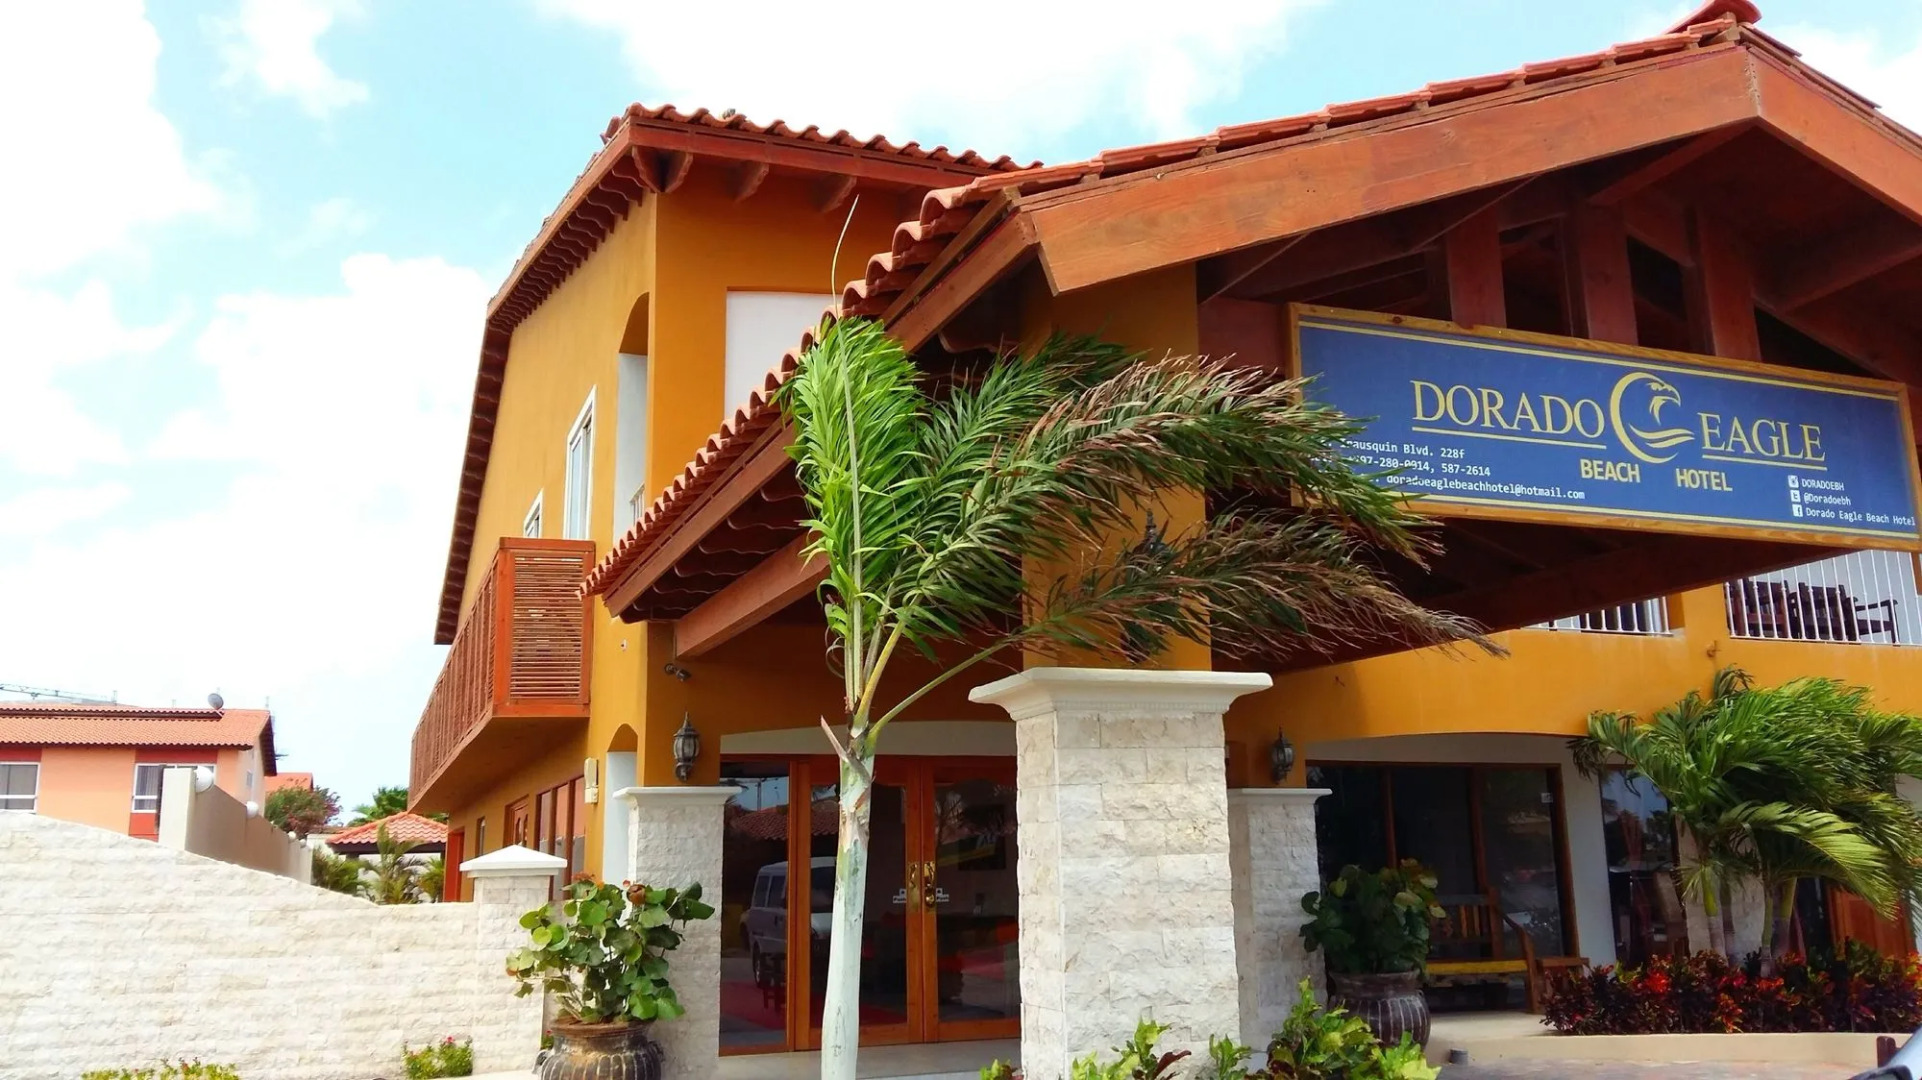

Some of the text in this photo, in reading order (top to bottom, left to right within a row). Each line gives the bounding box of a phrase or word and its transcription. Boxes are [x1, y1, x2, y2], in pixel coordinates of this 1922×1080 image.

[1410, 380, 1826, 462] DORADO EAGLE
[1403, 444, 1434, 456] Blvd.
[1440, 447, 1465, 459] 228f
[1441, 463, 1491, 476] 587-2614
[1580, 458, 1733, 492] BEACH HOTEL
[1801, 478, 1845, 491] DORADOEBH
[1803, 492, 1852, 506] @Doradoebh
[1806, 507, 1916, 526] Dorado Eagle Beach Hotel
